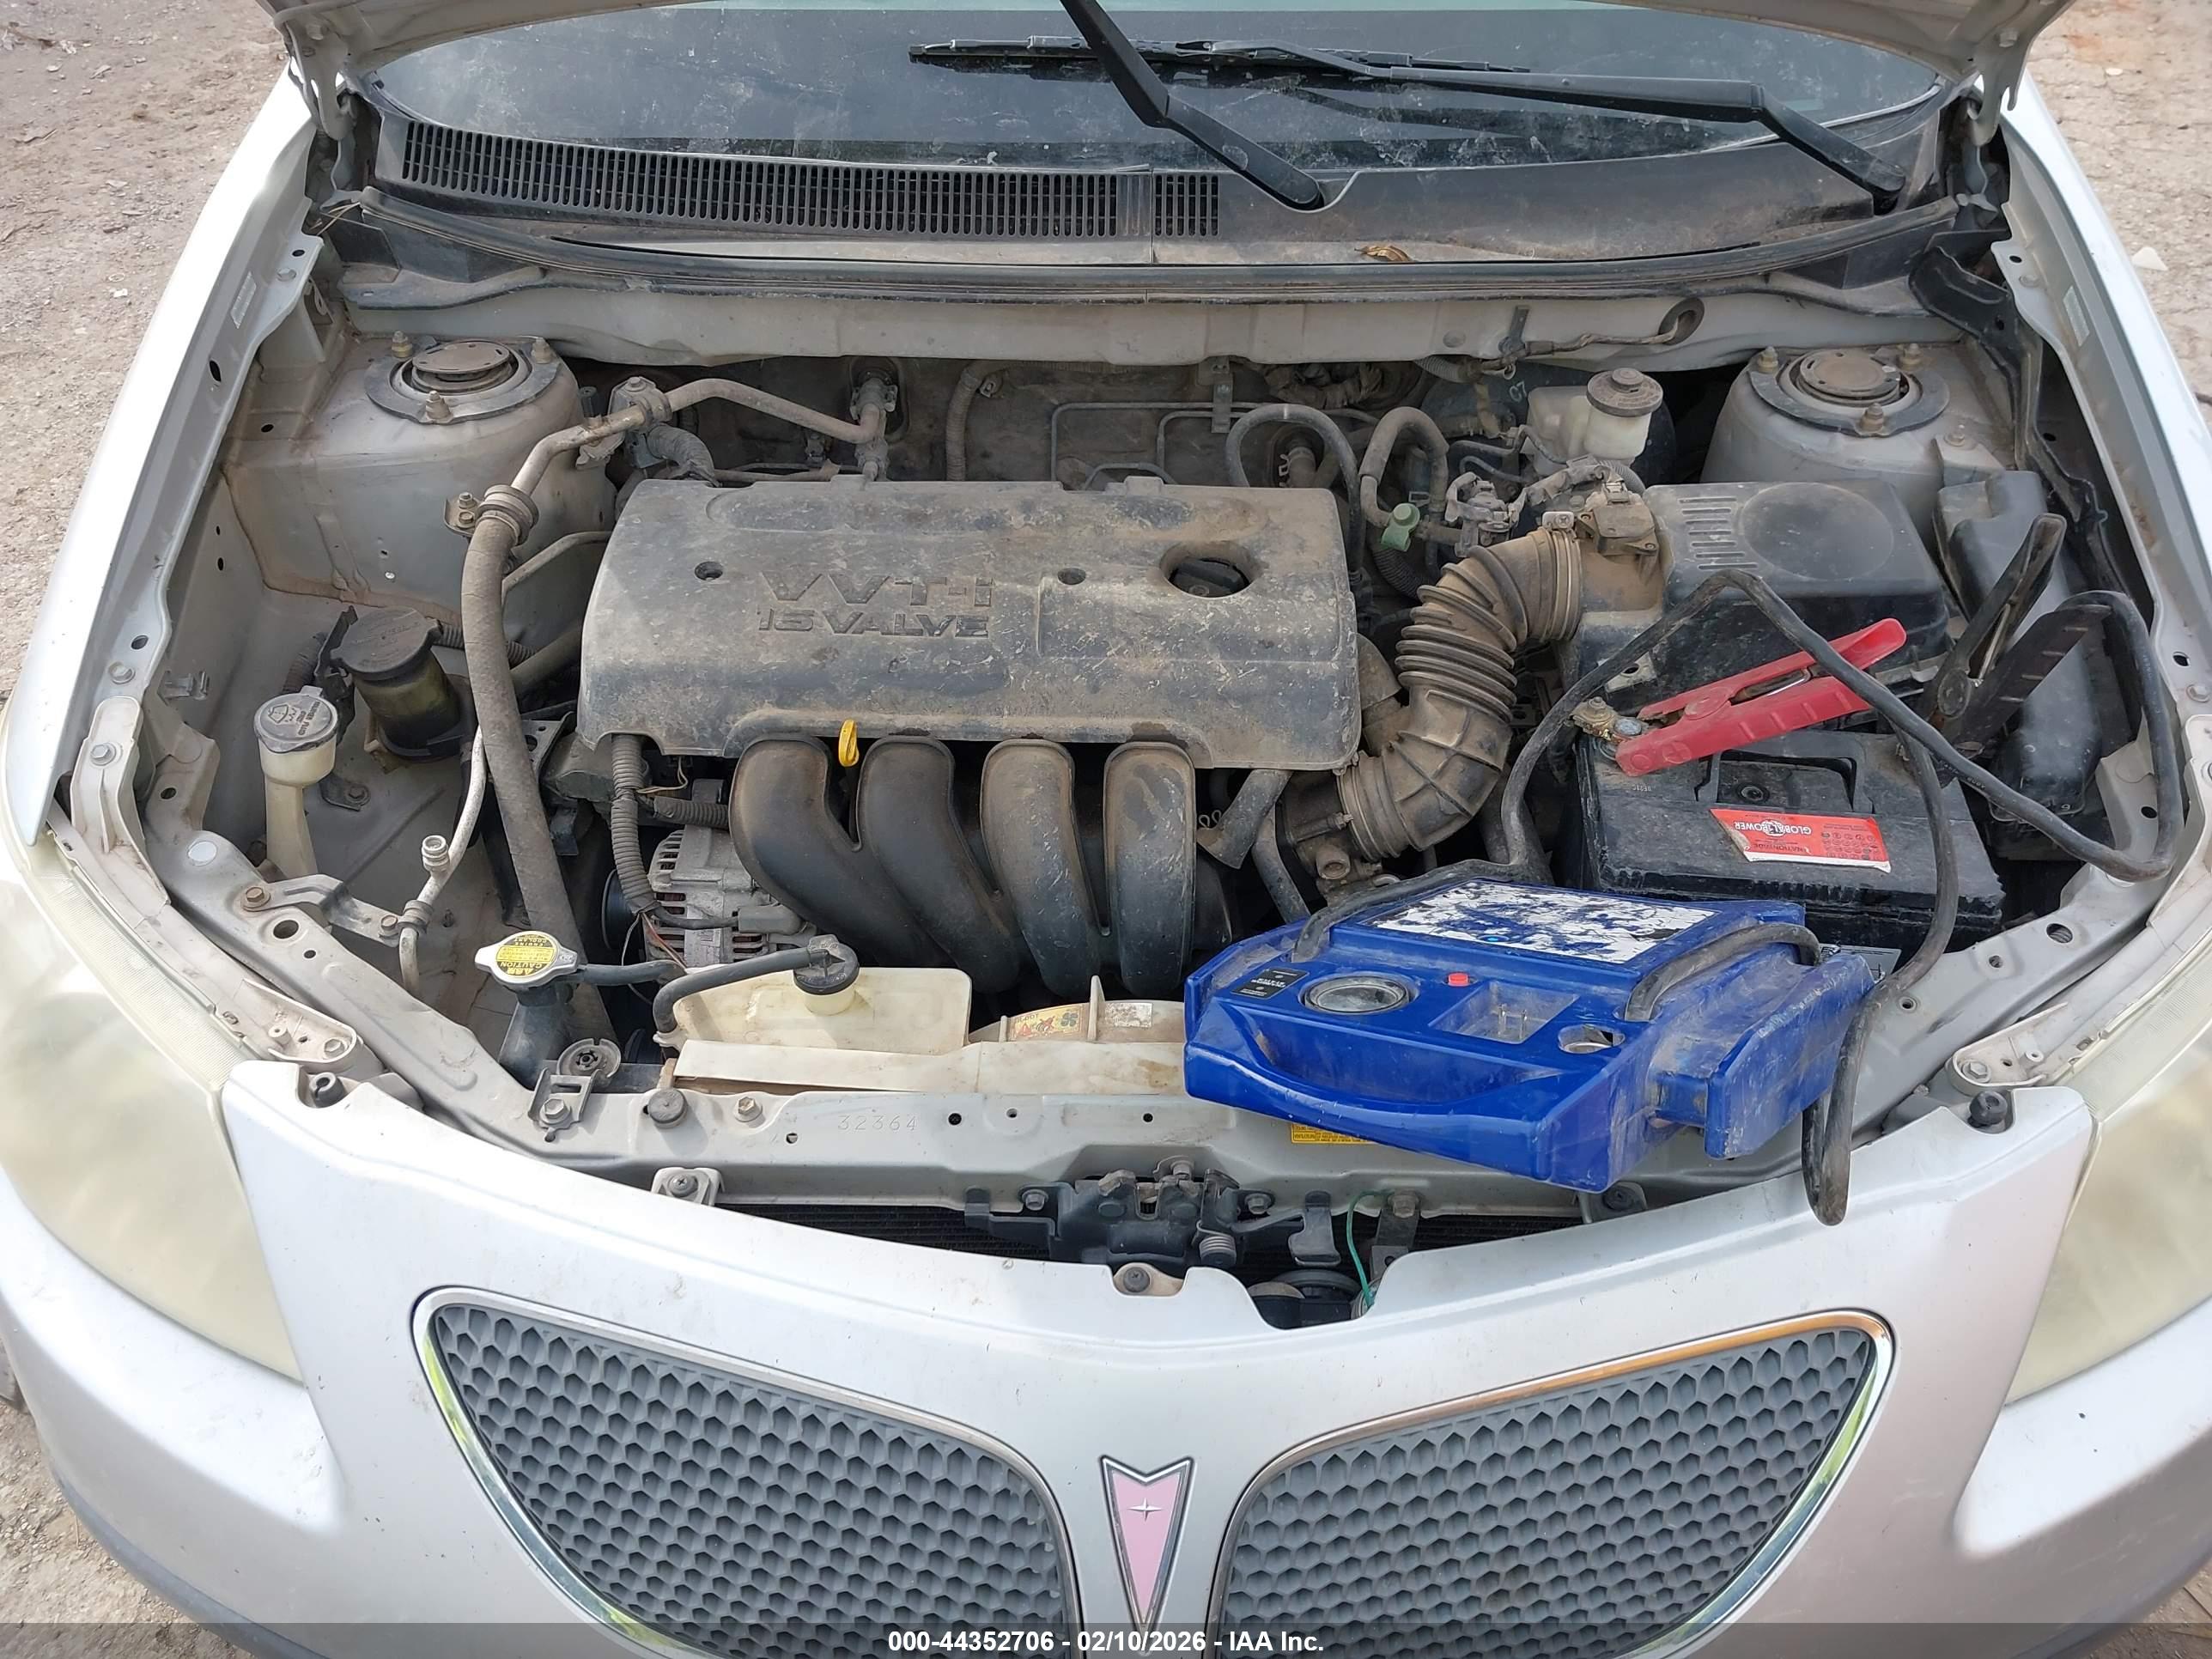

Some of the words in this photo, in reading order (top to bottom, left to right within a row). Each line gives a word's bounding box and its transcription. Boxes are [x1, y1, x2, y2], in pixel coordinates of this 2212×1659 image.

[1735, 820, 1768, 831] POWER
[1773, 823, 1812, 835] GLOBAL
[837, 1115, 917, 1132] 32364
